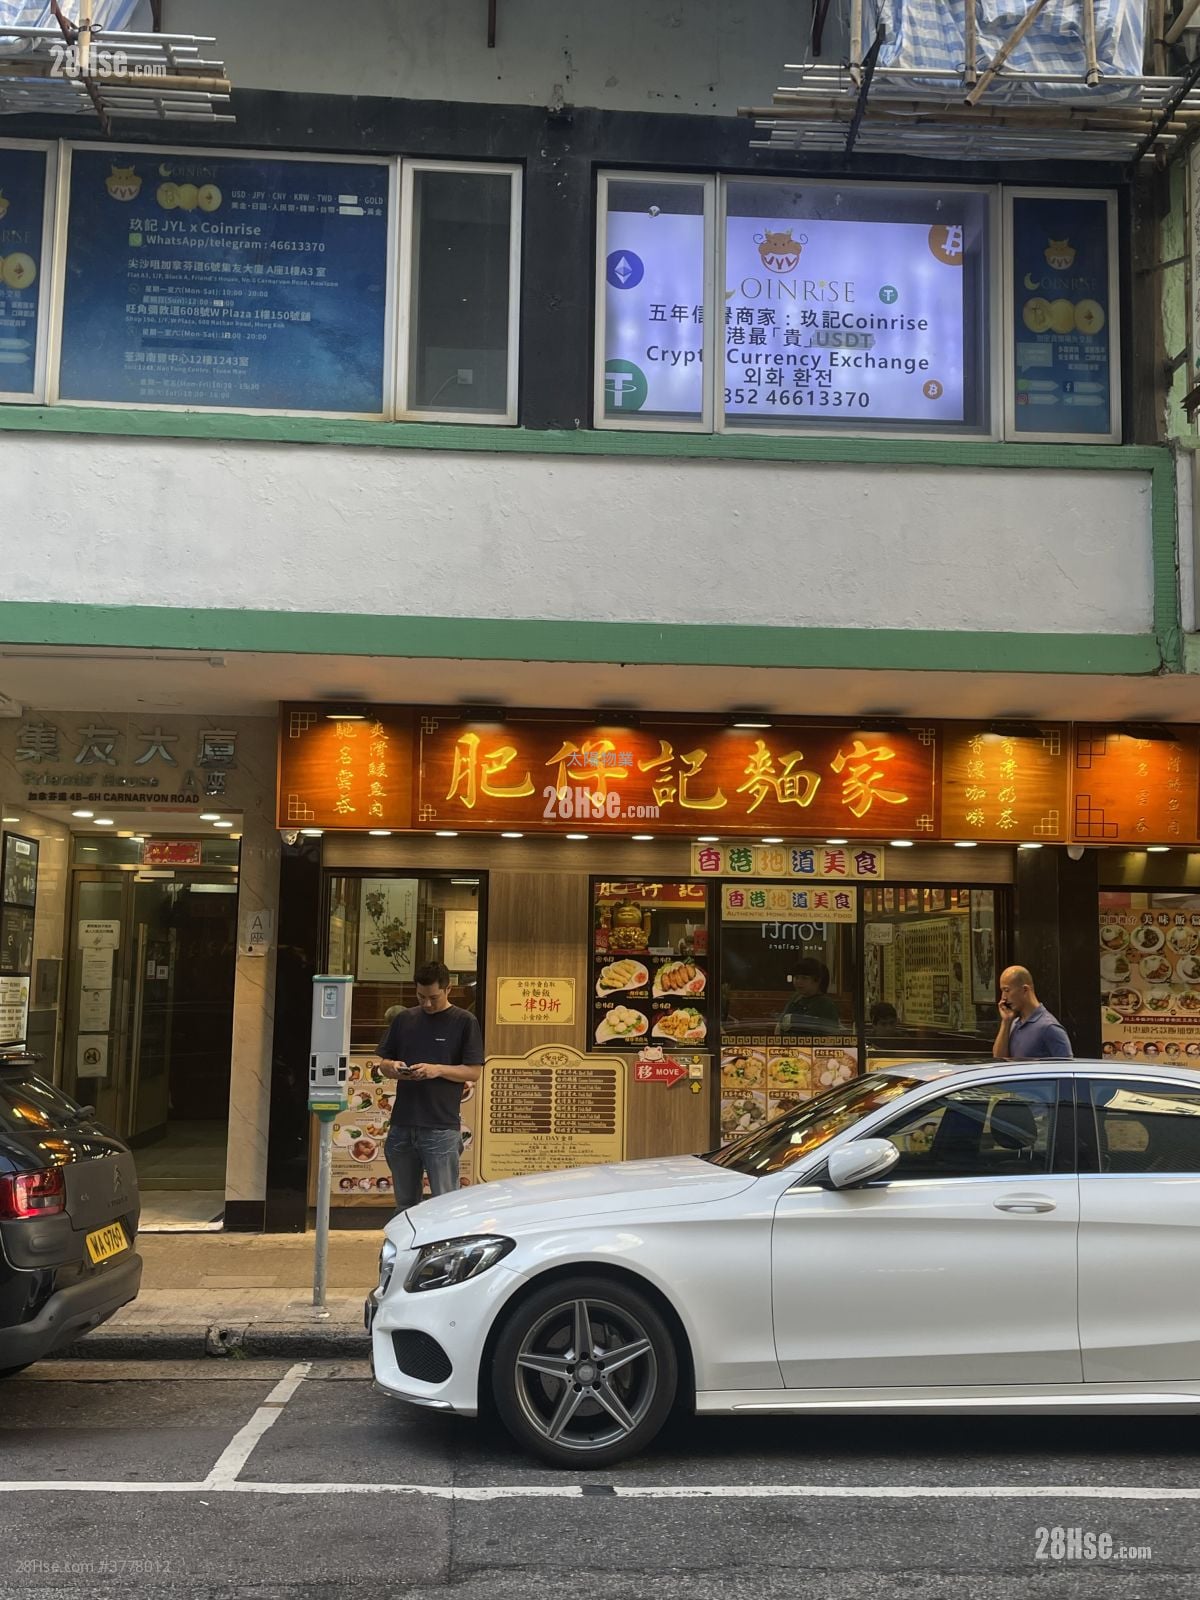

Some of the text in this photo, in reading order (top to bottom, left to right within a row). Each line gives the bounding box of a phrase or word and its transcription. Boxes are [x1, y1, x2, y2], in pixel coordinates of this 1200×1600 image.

[130, 218, 158, 232] 玖記
[162, 221, 186, 232] JYL
[201, 222, 261, 236] Coinrise
[270, 241, 325, 252] 46613370
[222, 308, 251, 319] Plaza
[646, 346, 929, 374] Crypt Currency Exchange
[744, 367, 832, 387] 외화 환전
[724, 388, 870, 408] 852 46613370
[16, 722, 238, 768] 集友大廈
[103, 793, 168, 803] CARNARVON
[170, 794, 199, 803] ROAD
[698, 848, 878, 875] 香港地道美食
[728, 890, 851, 910] 香港地道美食
[510, 997, 561, 1012] 一律9折
[638, 1065, 652, 1078] 移
[90, 1234, 108, 1257] WA
